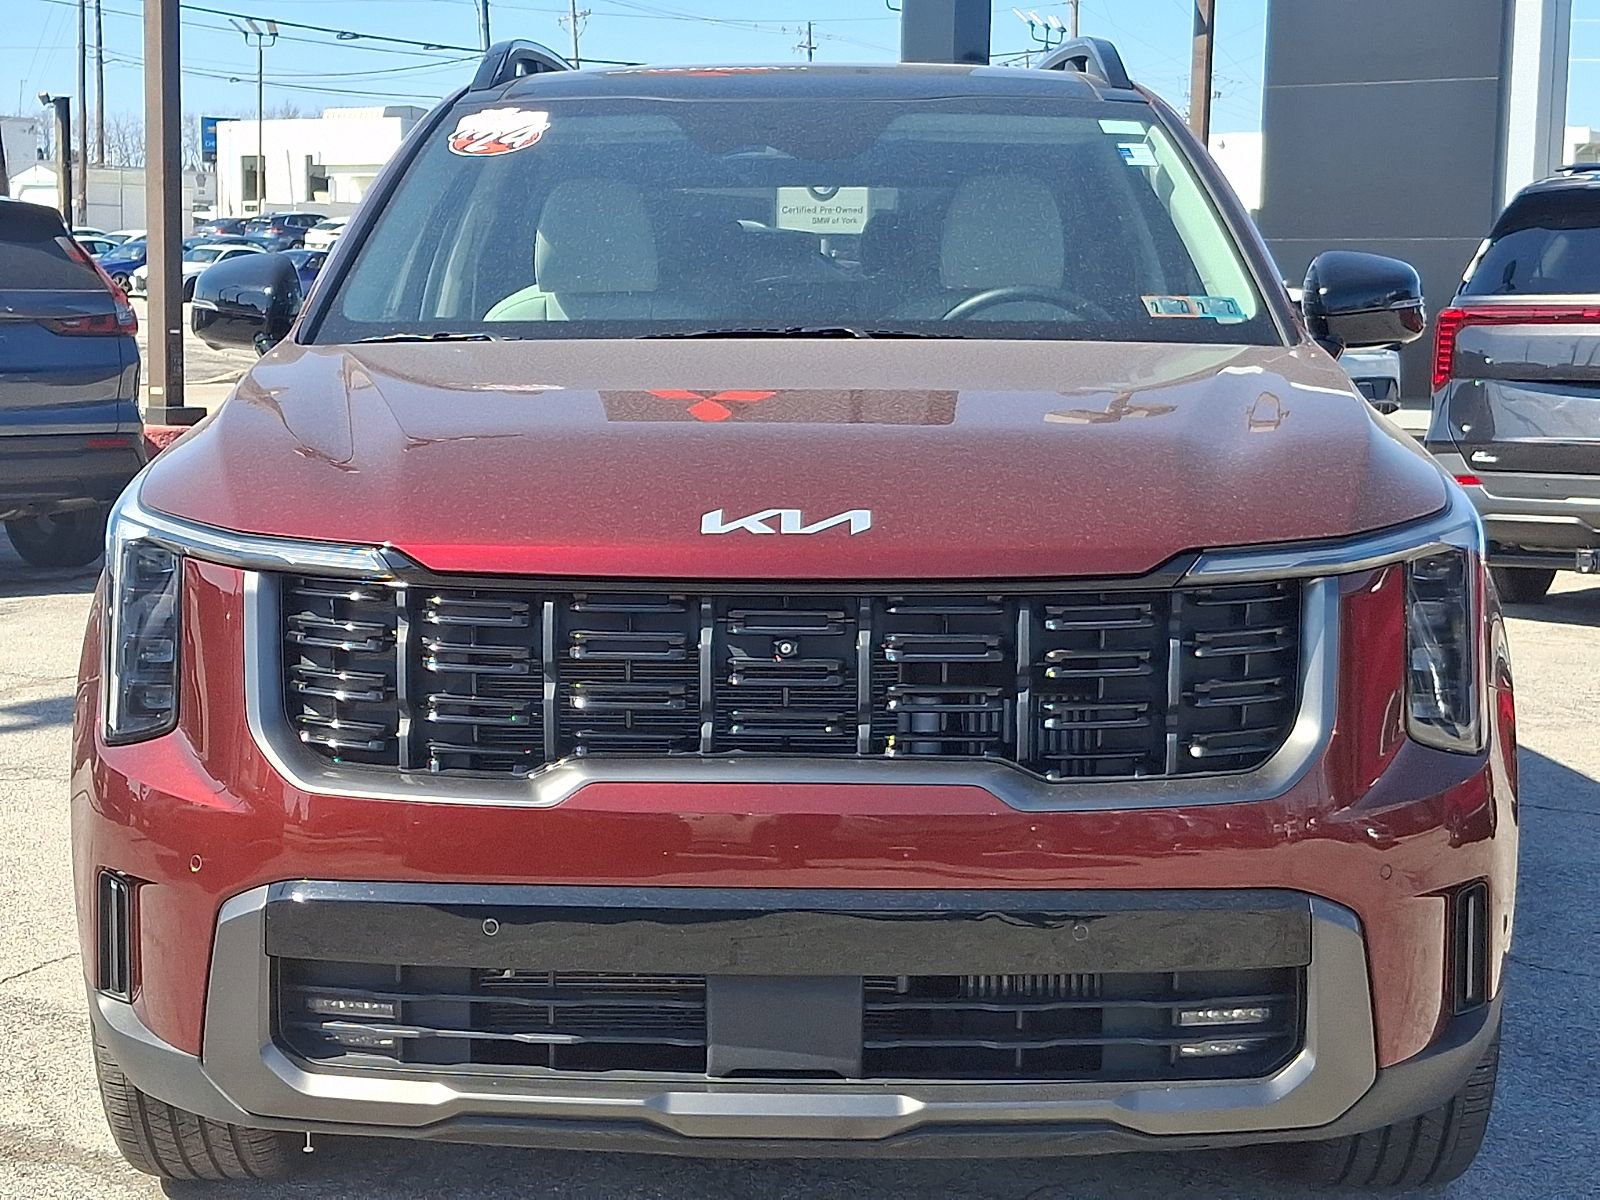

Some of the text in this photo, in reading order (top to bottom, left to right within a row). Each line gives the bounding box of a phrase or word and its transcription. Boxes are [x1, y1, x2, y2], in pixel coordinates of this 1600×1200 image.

[781, 205, 864, 215] Certified Pre-Owned
[811, 217, 857, 225] BMW of York
[700, 508, 872, 536] KIA
